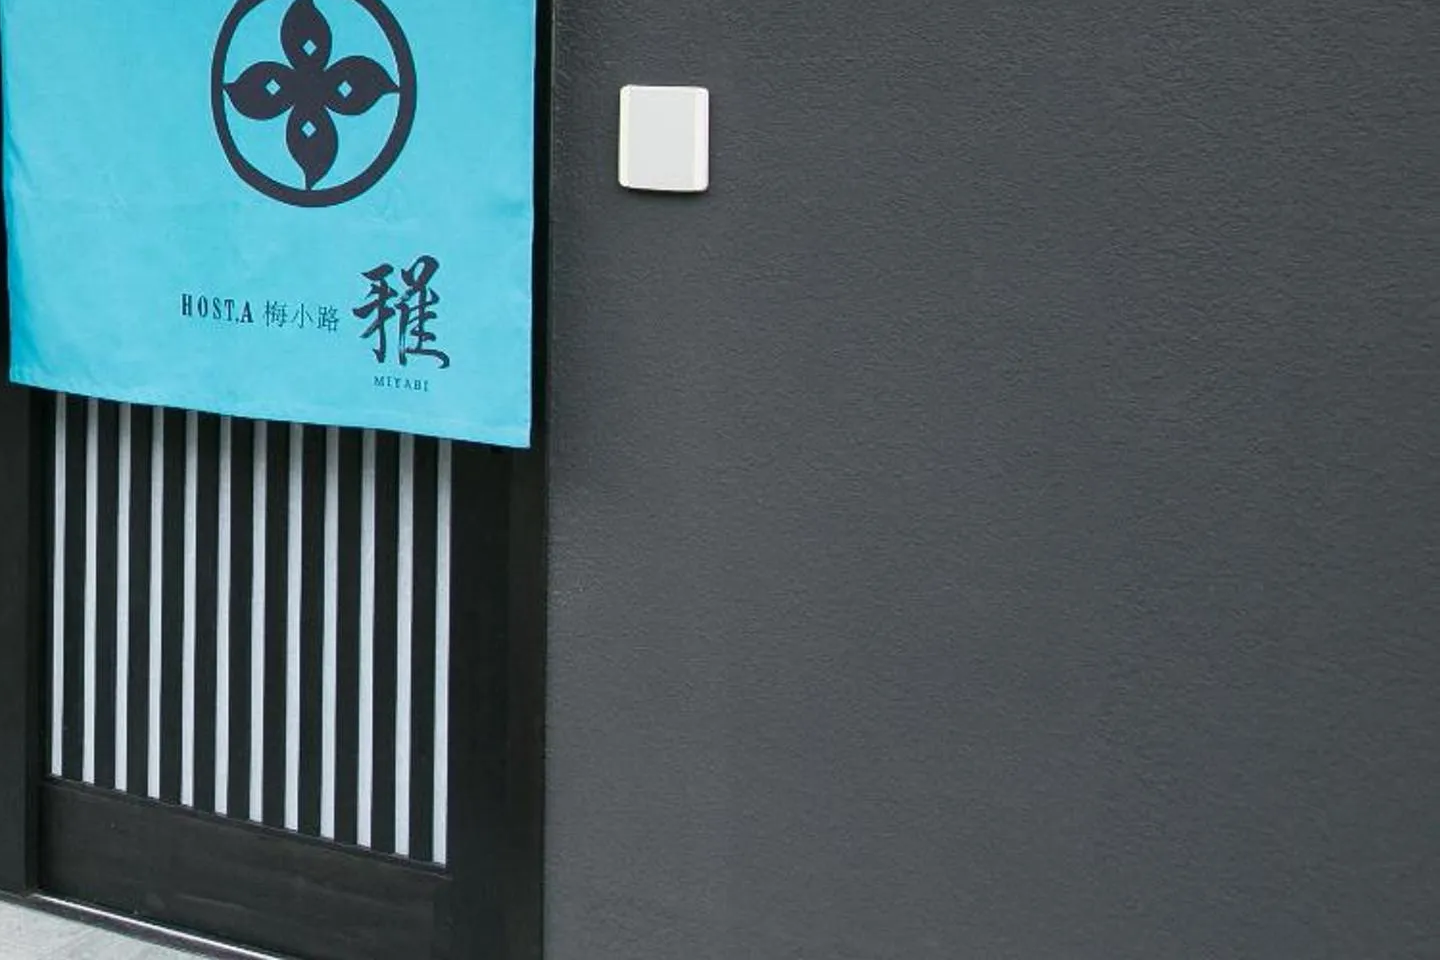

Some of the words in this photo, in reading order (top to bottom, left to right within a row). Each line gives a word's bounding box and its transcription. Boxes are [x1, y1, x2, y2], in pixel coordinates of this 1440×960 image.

[181, 293, 254, 324] HOST.A
[264, 300, 340, 332] 梅小路
[373, 375, 429, 392] MIYABI
